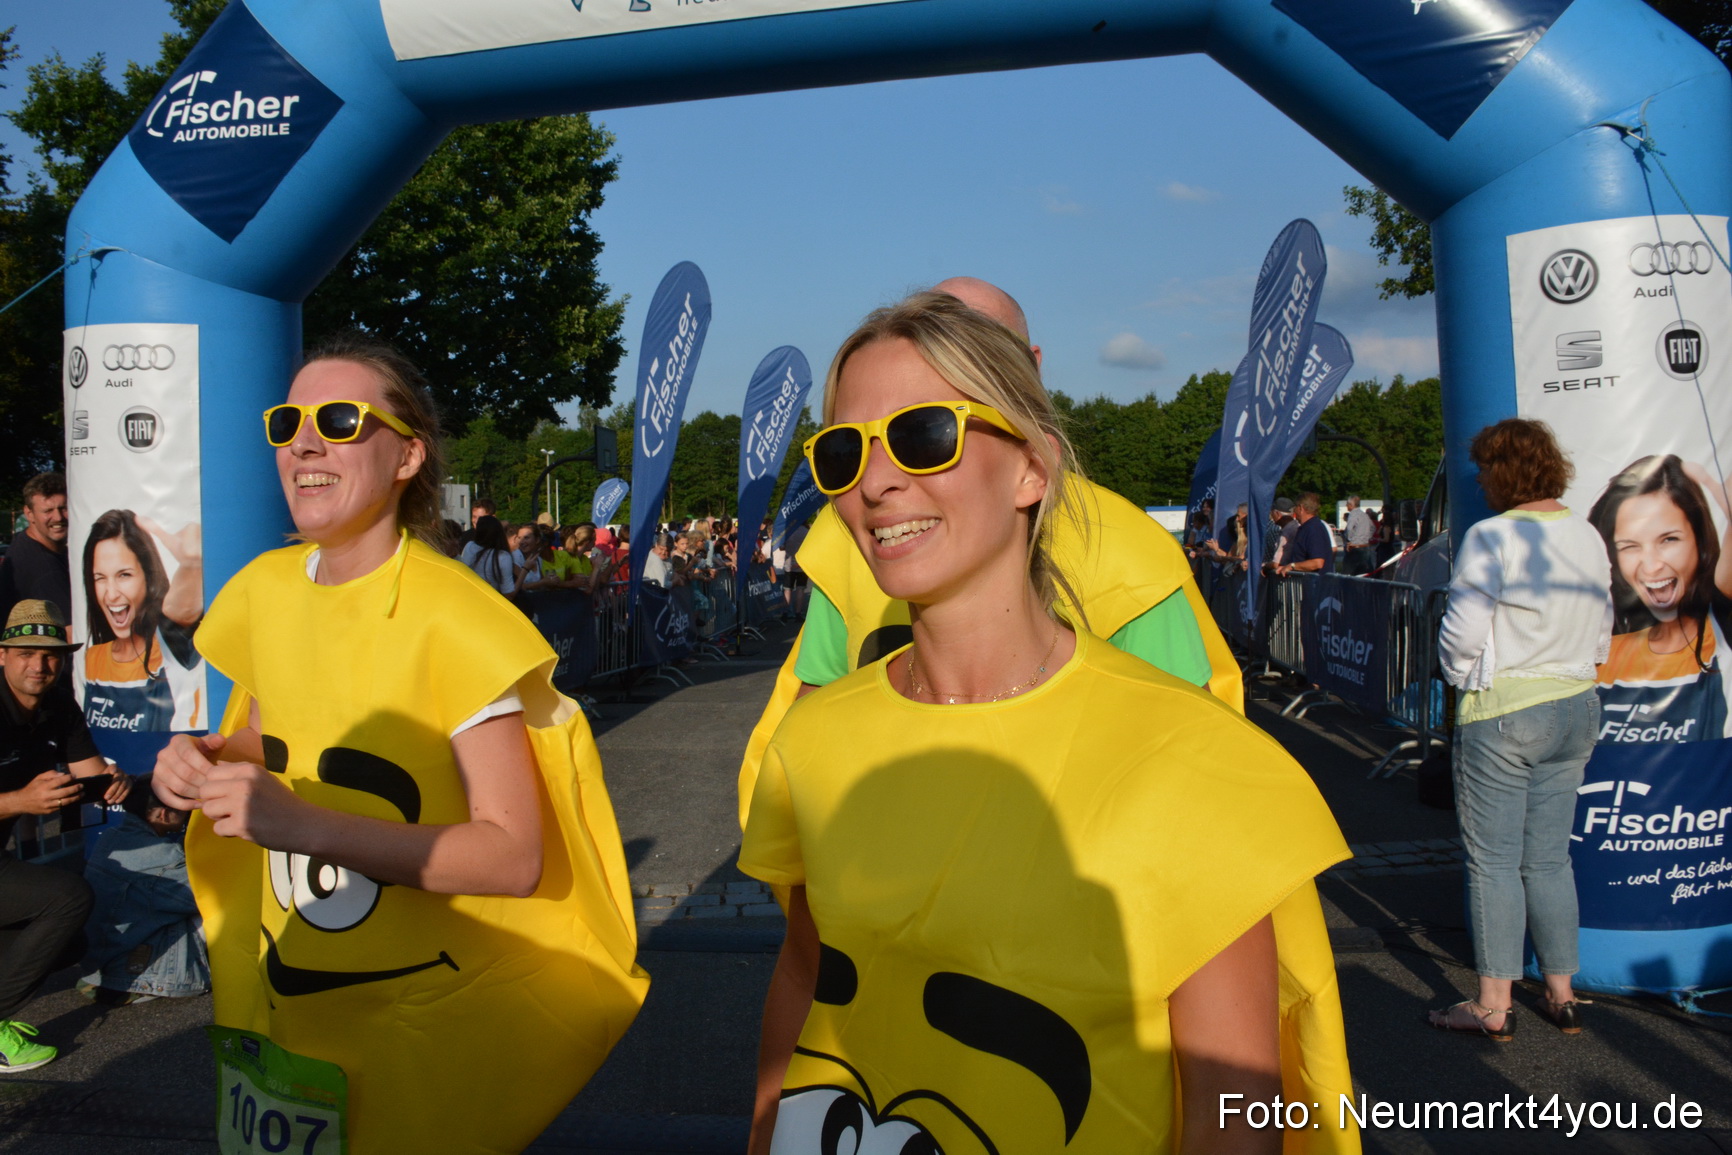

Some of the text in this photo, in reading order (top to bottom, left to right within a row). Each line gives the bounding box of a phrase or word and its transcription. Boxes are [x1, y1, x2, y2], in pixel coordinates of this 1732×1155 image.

[164, 90, 300, 128] Fischer
[172, 122, 291, 143] AUTOMOBILE
[1633, 285, 1674, 298] Audi
[1264, 251, 1307, 410] Fischer
[1279, 275, 1314, 406] AUTOMOBILE
[650, 292, 696, 435] Fischer
[1668, 337, 1699, 365] FIAT
[104, 378, 134, 388] Audi
[664, 316, 699, 432] AUTOMOBILE
[1543, 375, 1621, 394] SEAT
[1288, 361, 1332, 434] TOMOBILE
[127, 419, 154, 441] FIAT
[755, 366, 796, 465] Fischer
[769, 384, 801, 463] AUTOMOBILE
[781, 483, 818, 519] Frischma
[1321, 624, 1374, 666] Fischer
[90, 708, 145, 733] Fischer
[1599, 717, 1697, 744] Fischer
[1583, 805, 1732, 836] Fischer
[1598, 834, 1725, 852] AUTOMOBILE
[1627, 868, 1661, 886] und
[1665, 864, 1696, 880] das
[1671, 880, 1715, 905] fährt
[229, 1082, 328, 1155] 1007
